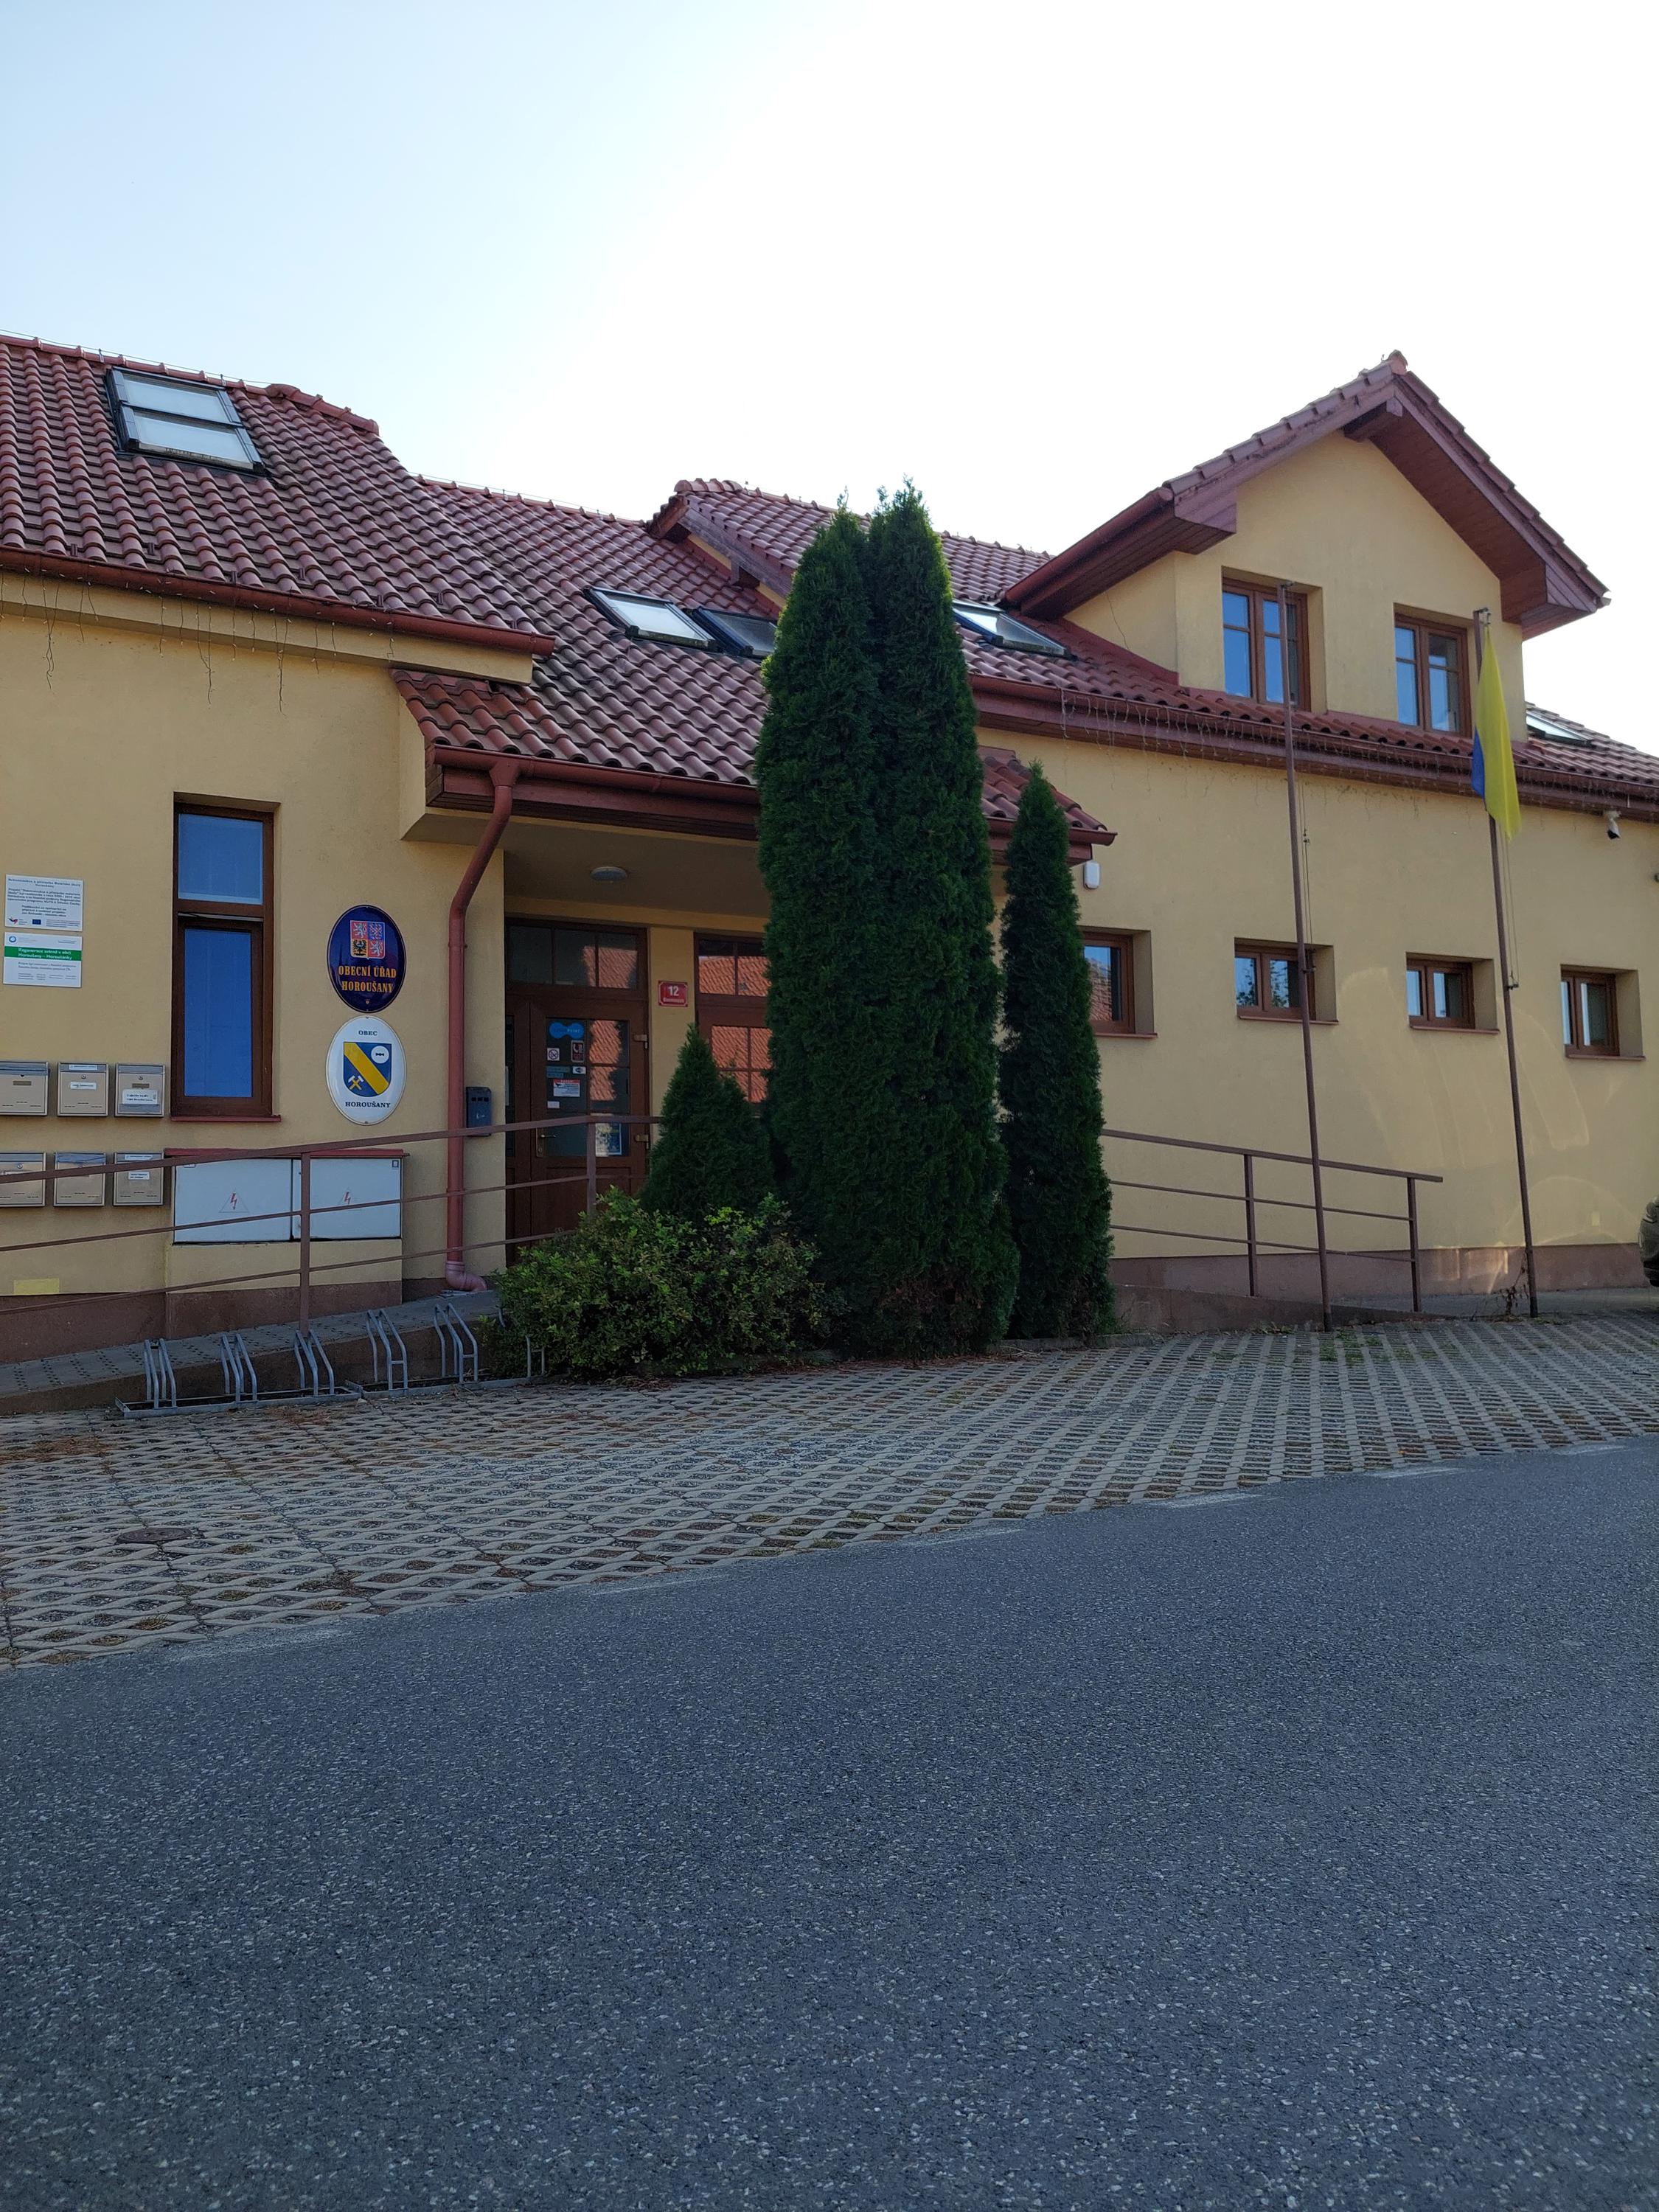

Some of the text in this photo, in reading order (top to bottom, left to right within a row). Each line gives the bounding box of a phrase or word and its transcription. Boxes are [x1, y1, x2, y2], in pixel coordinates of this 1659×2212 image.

[338, 965, 397, 978] OBECNÍ ÚŘAD
[341, 981, 394, 993] HOROUŠANY
[668, 986, 679, 996] 12
